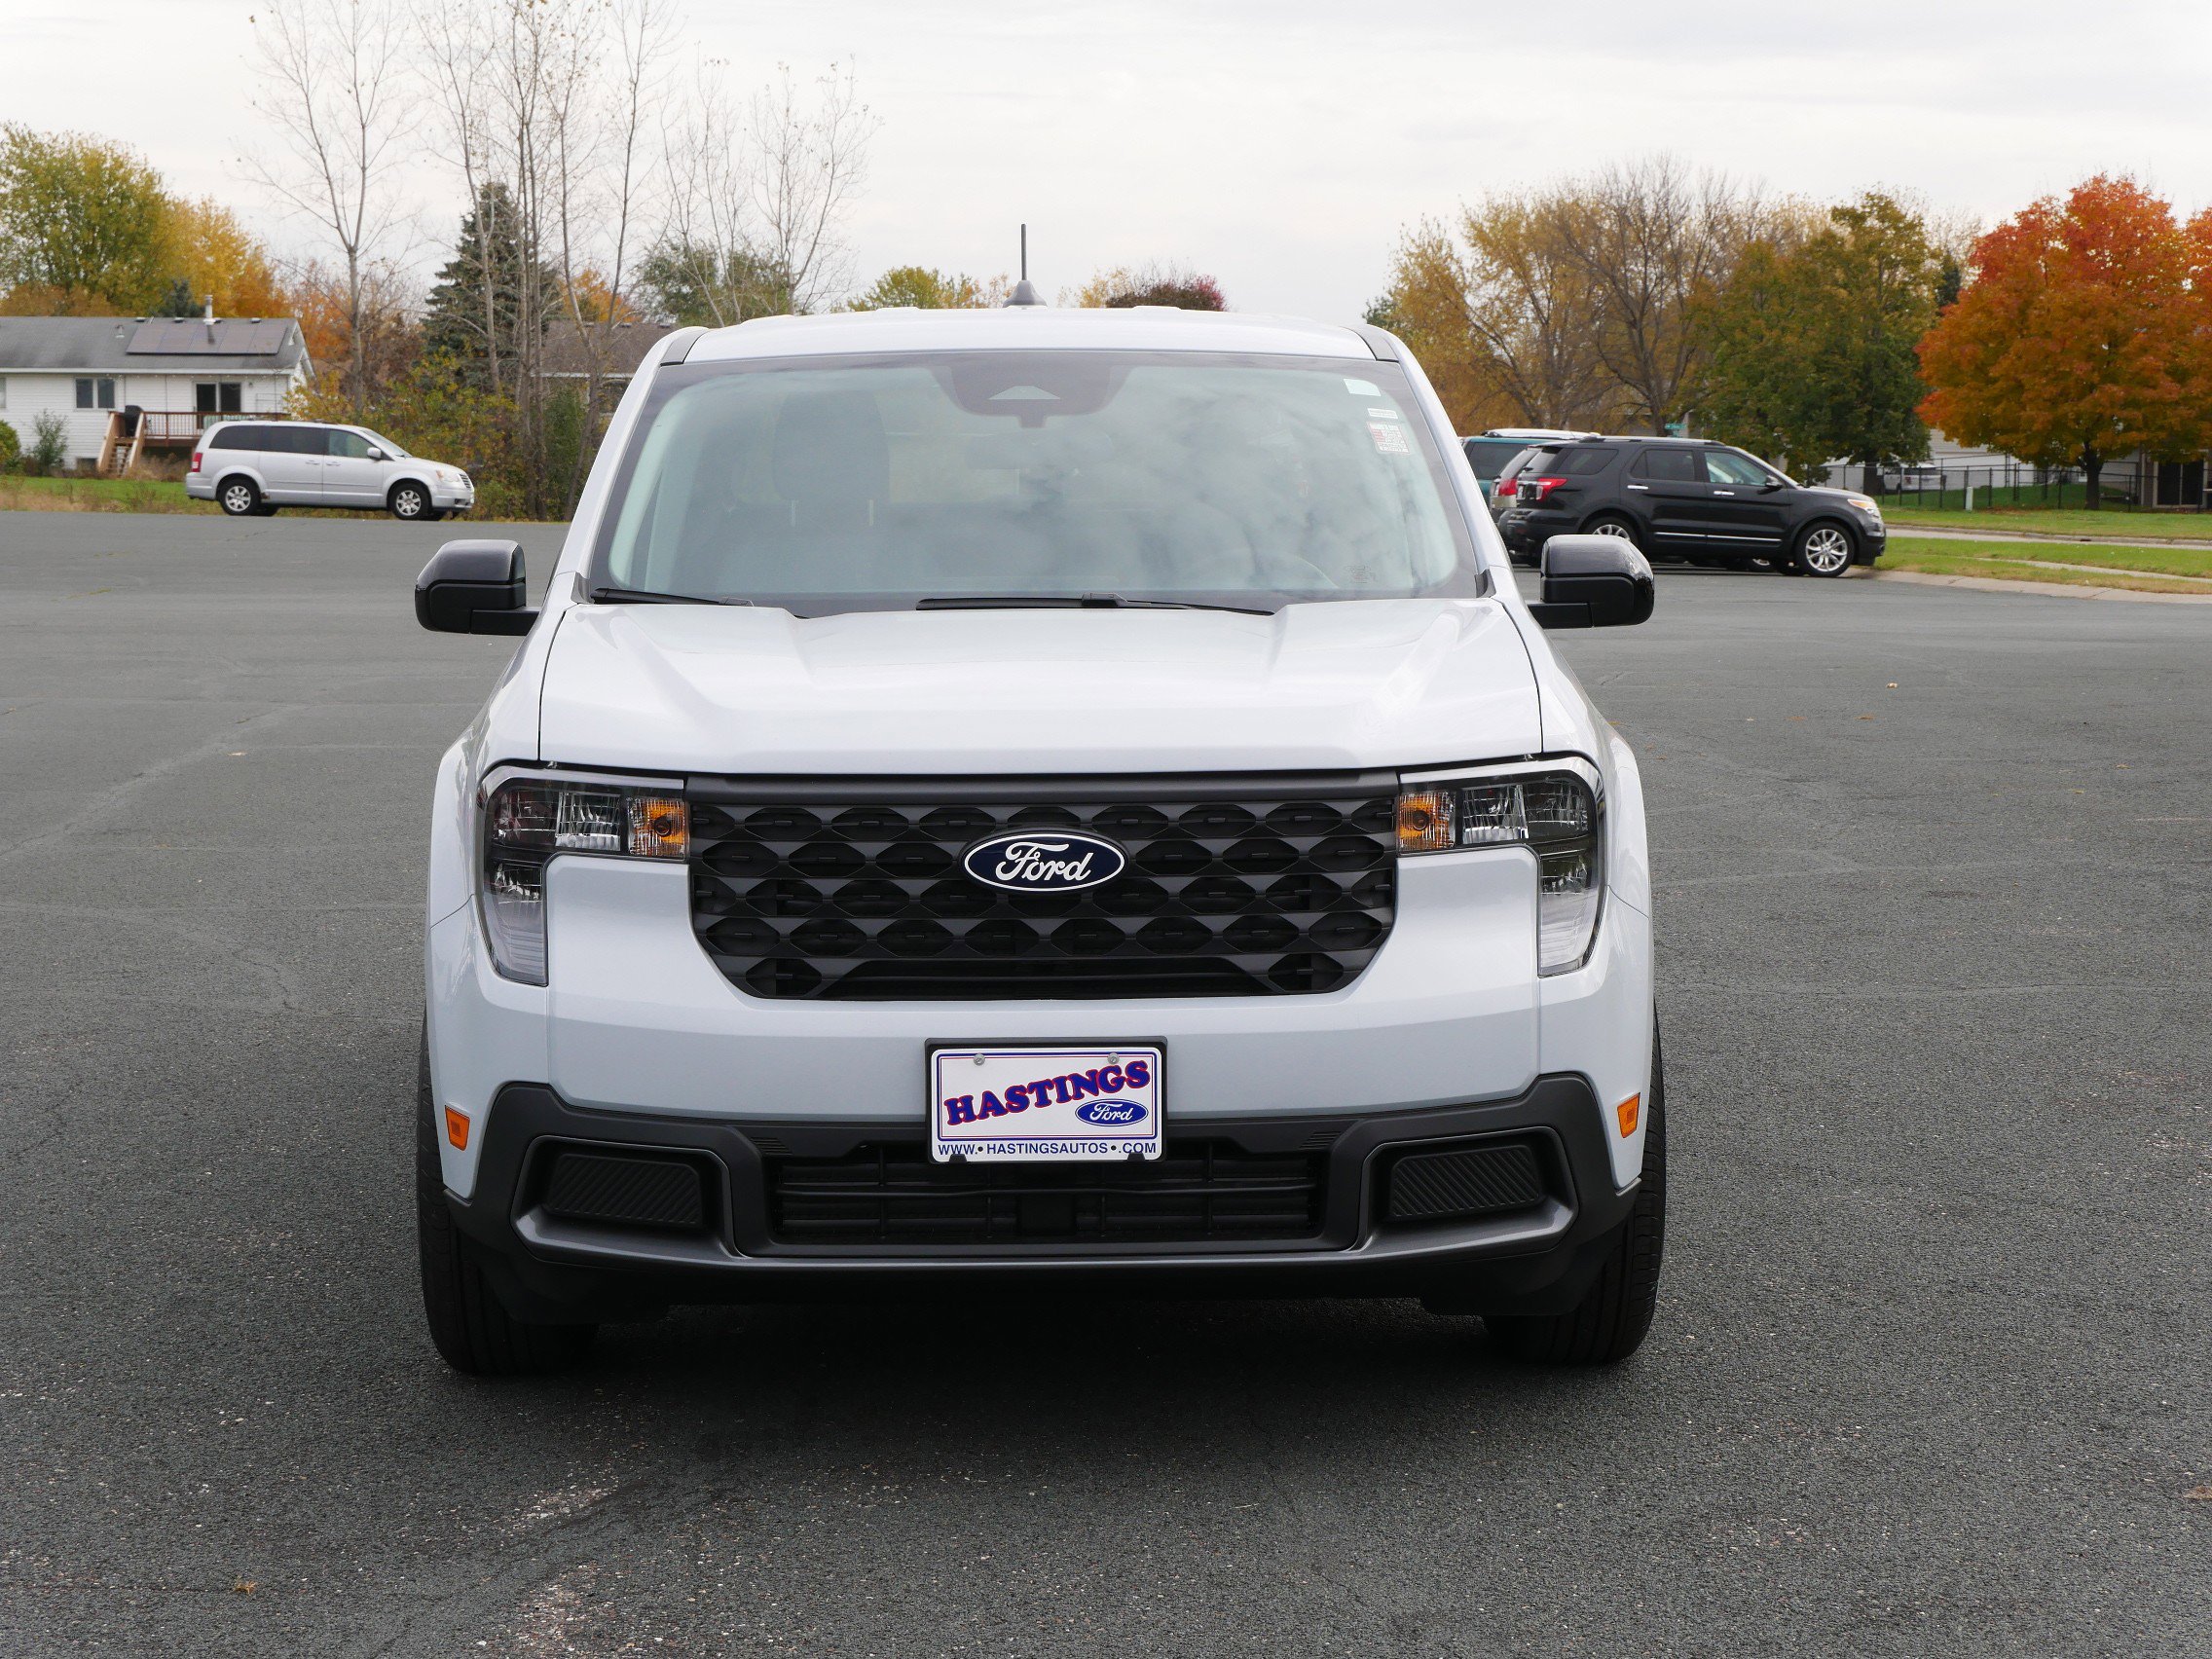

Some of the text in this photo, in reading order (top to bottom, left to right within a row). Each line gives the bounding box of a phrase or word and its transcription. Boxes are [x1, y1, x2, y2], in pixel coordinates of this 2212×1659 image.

[995, 841, 1094, 881] Ford
[944, 1060, 1150, 1125] HASTINGS
[1089, 1102, 1133, 1121] Ford
